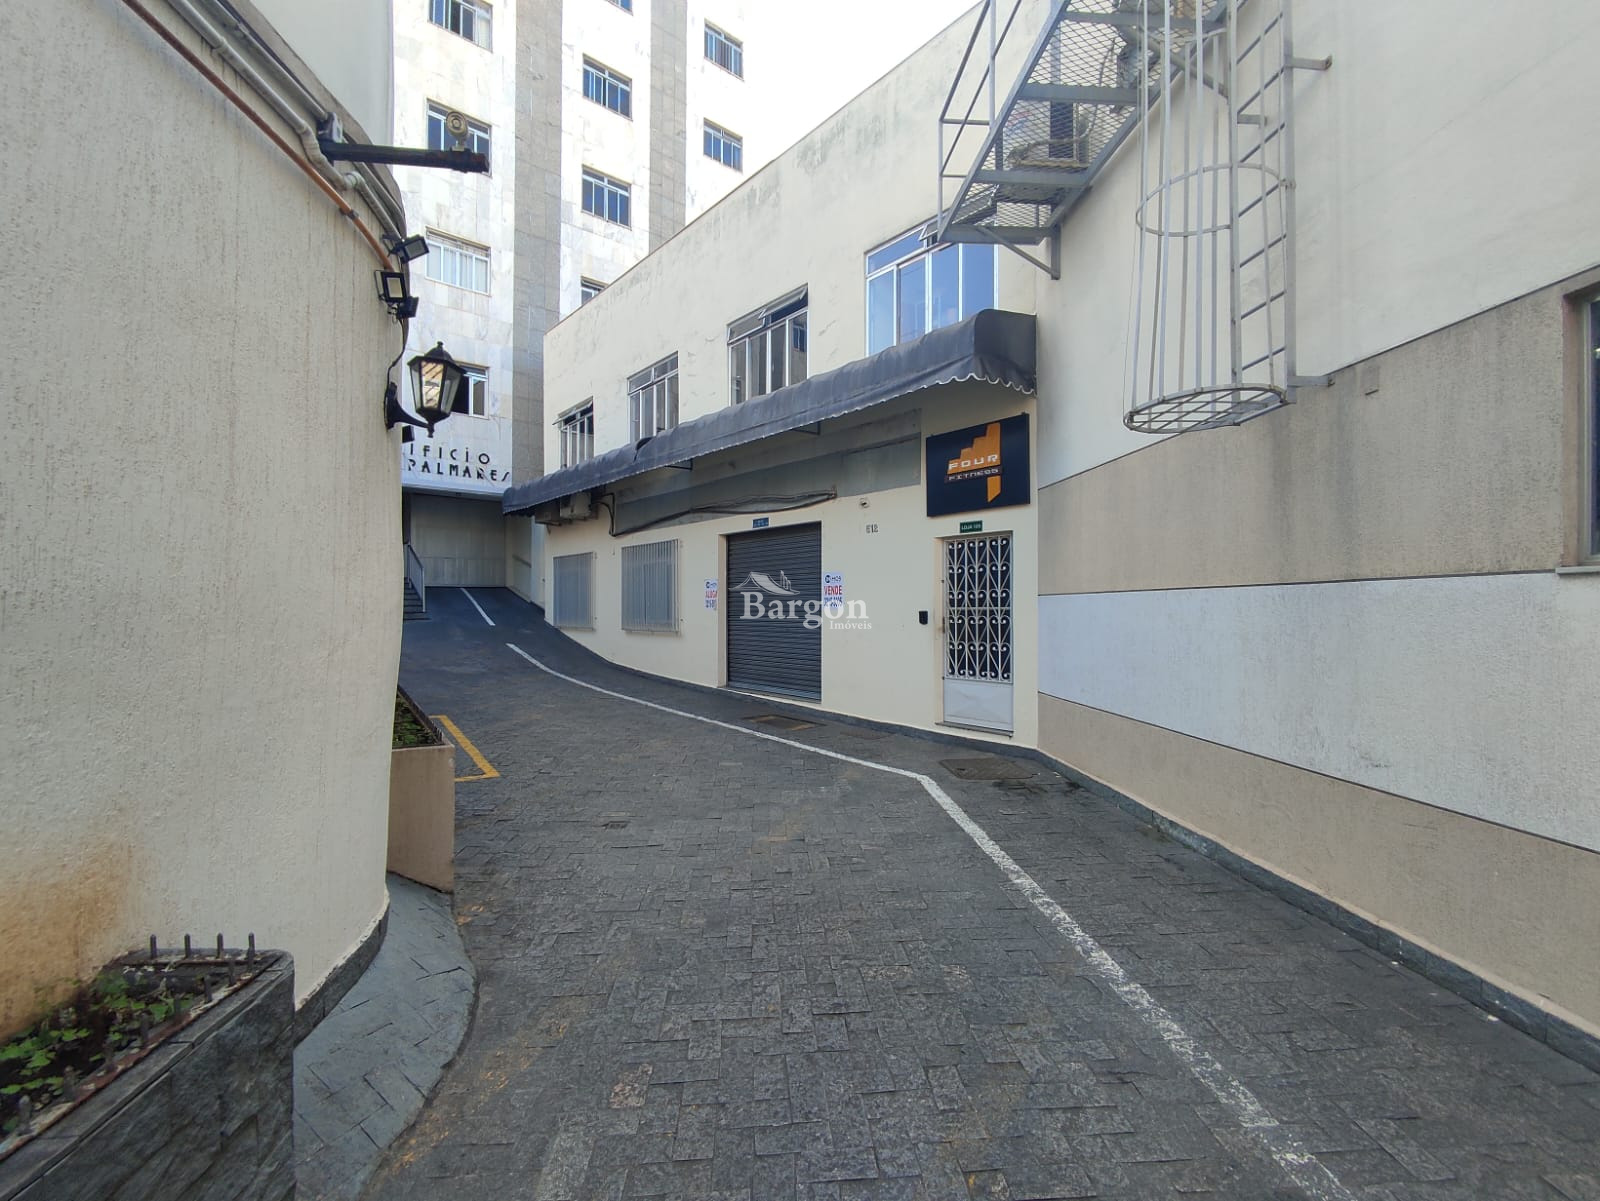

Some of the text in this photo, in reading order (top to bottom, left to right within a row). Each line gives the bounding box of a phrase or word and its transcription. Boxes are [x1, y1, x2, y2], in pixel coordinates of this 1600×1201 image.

[948, 454, 998, 470] FOUR
[948, 468, 999, 480] FITNESS
[824, 585, 842, 595] VENDE
